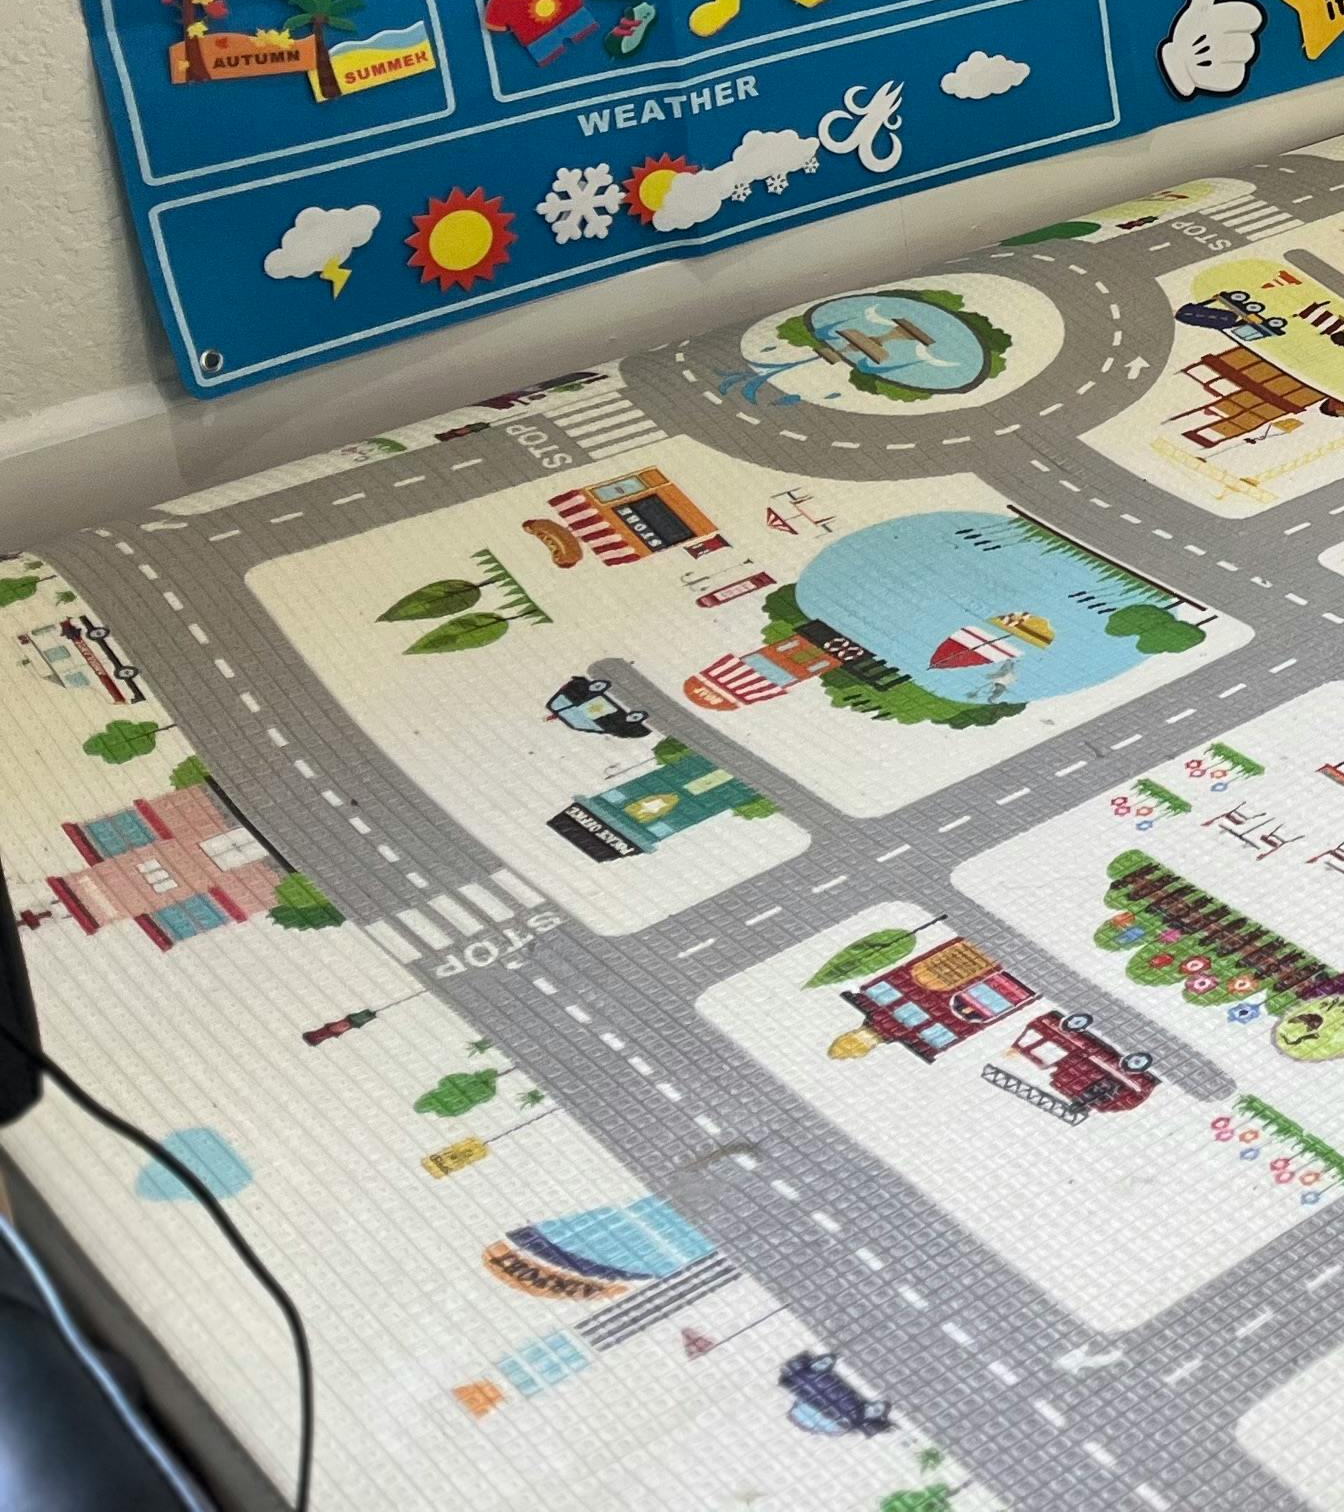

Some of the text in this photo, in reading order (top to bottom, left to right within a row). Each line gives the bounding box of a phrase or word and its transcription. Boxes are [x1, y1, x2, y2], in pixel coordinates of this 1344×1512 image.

[212, 49, 302, 71] AUTUMN
[345, 50, 429, 85] SUMMER
[578, 75, 760, 136] WEATHER
[1169, 219, 1230, 252] STOP
[506, 421, 571, 472] STOP
[620, 503, 665, 550] STORE
[436, 911, 566, 979] STOP
[489, 1250, 605, 1299] AIRPORT
